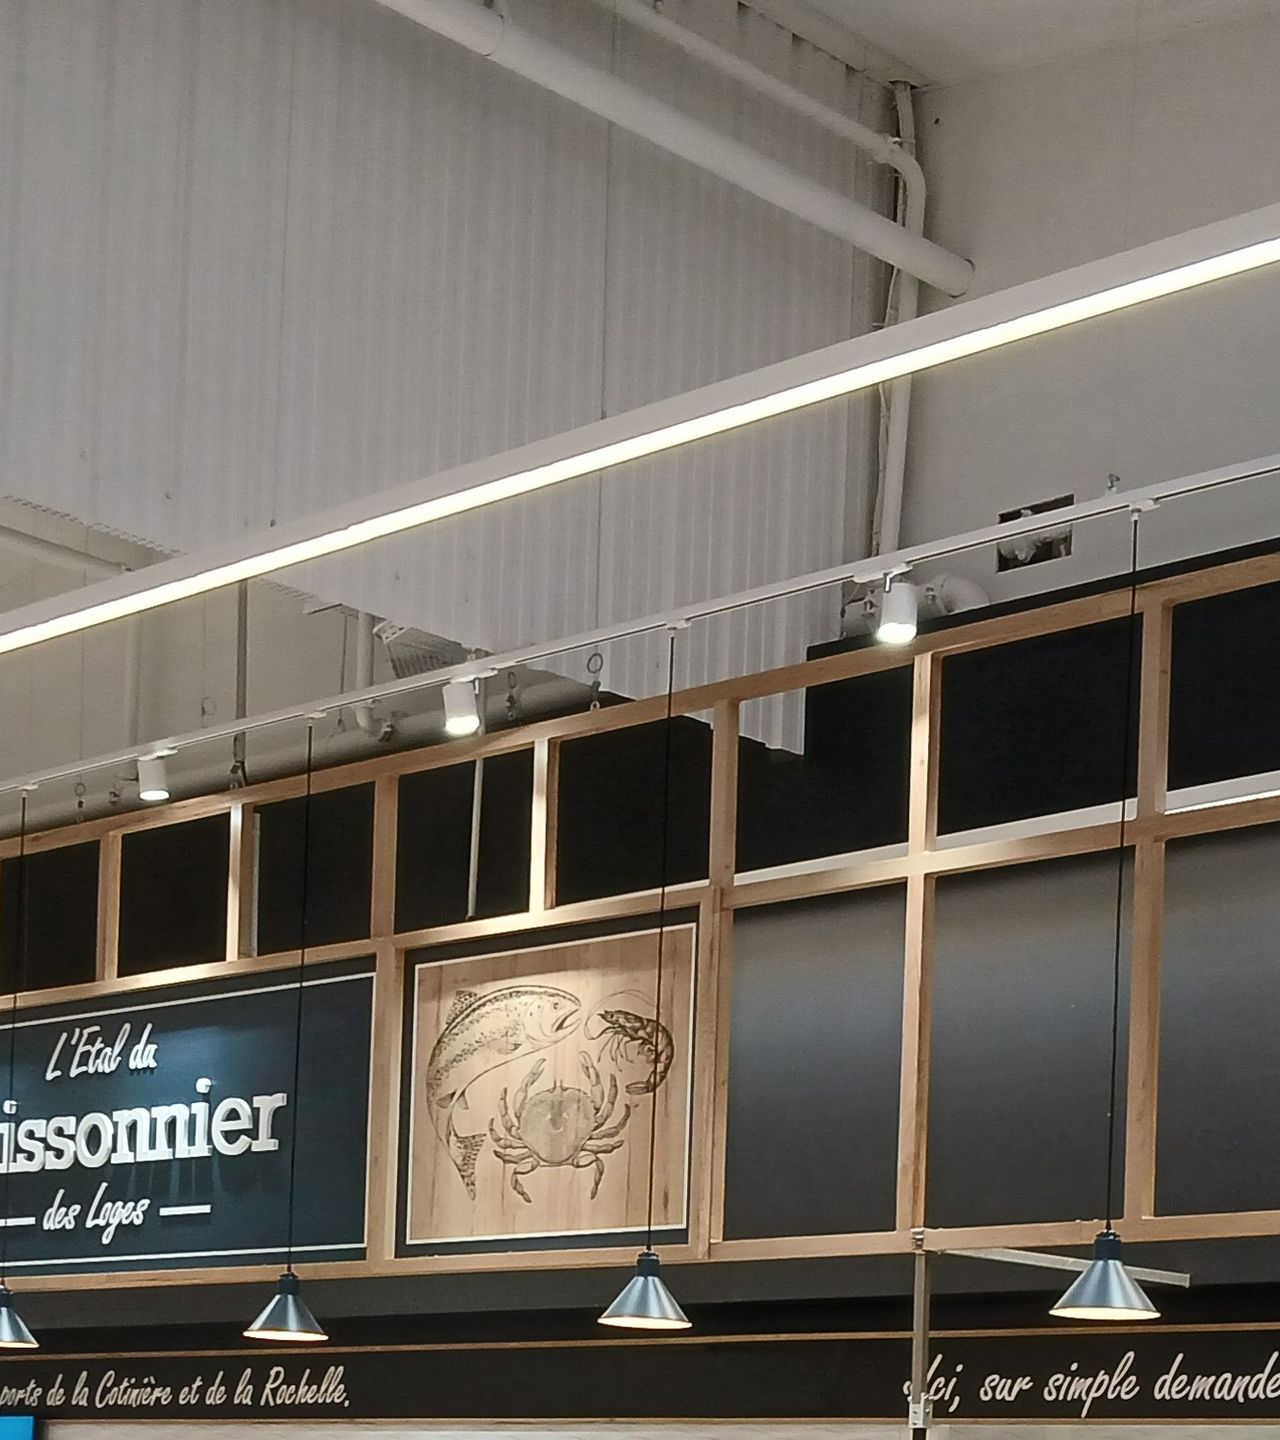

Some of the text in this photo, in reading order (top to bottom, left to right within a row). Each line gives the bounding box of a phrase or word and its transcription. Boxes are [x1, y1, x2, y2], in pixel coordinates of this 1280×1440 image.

[42, 1183, 149, 1244] des Loges
[46, 1376, 67, 1406] de
[70, 1372, 90, 1408] la
[94, 1370, 173, 1410] Cotinière
[178, 1377, 201, 1406] et
[205, 1371, 229, 1406] de
[232, 1367, 254, 1405] la
[260, 1364, 351, 1408] Rochelle.
[980, 1373, 1033, 1402] sur
[1042, 1351, 1140, 1418] simple
